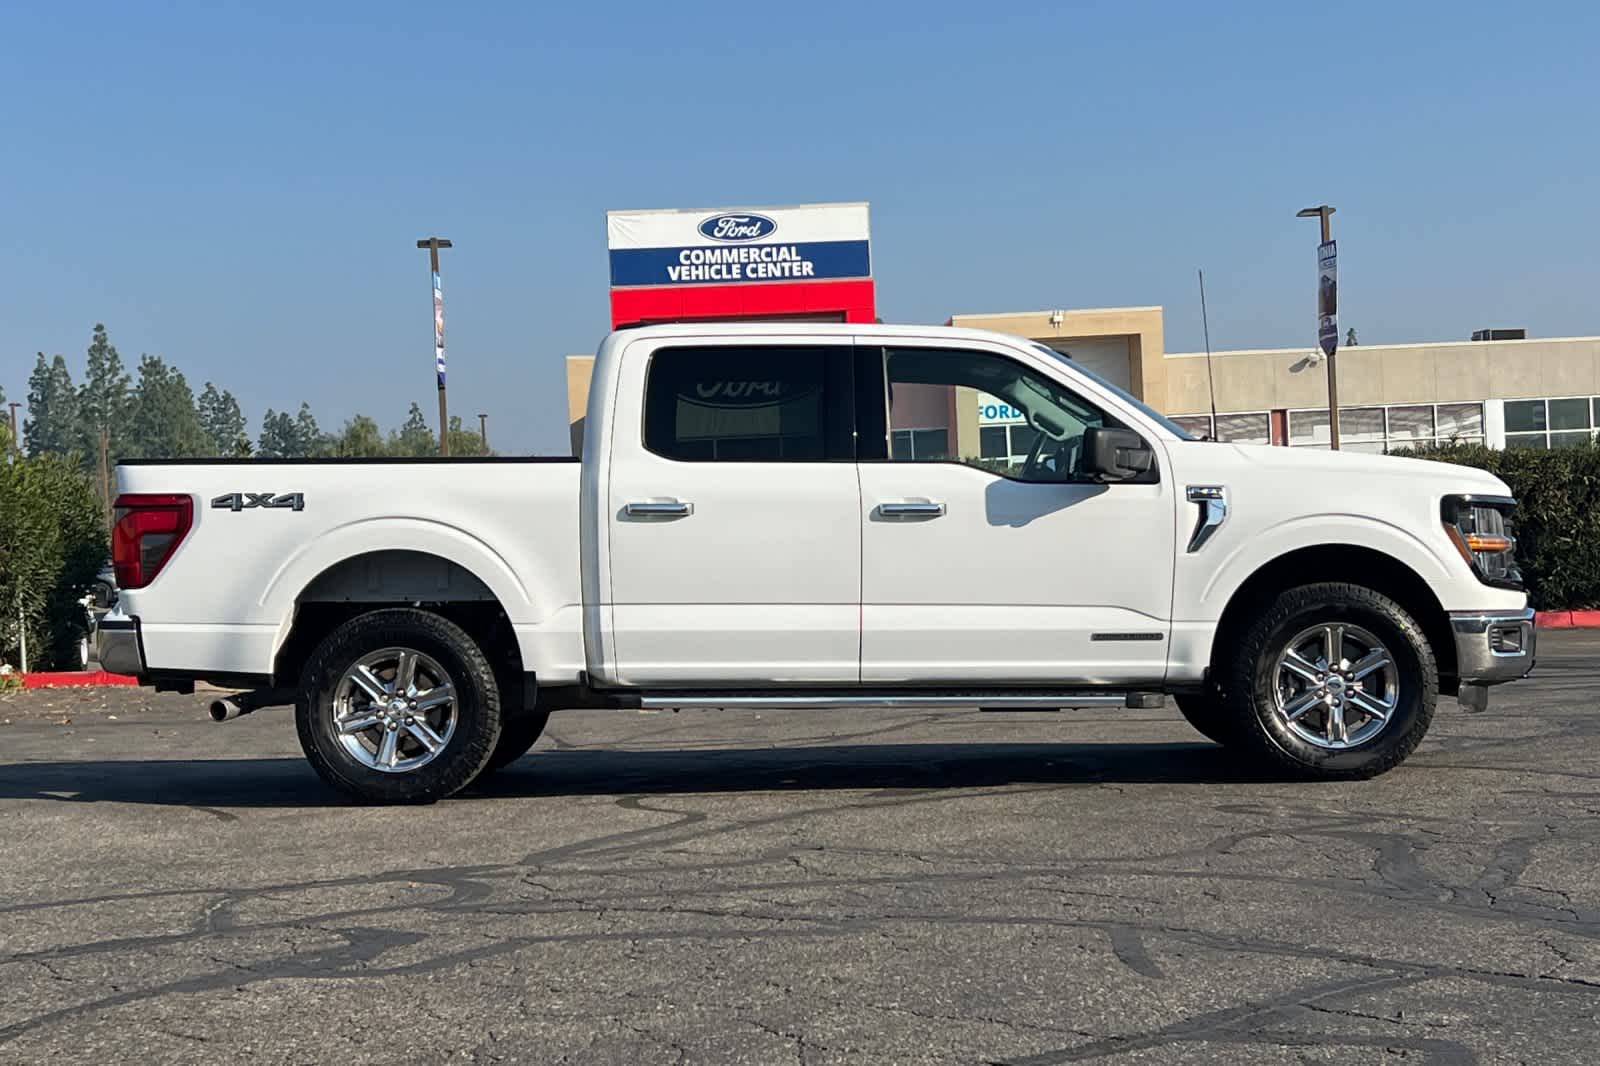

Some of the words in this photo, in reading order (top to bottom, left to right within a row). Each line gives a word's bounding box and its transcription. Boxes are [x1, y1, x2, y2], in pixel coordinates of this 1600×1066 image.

[713, 216, 761, 237] Ford
[679, 246, 801, 265] COMMERCIAL
[667, 264, 741, 281] VEHICLE
[745, 261, 814, 278] CENTER
